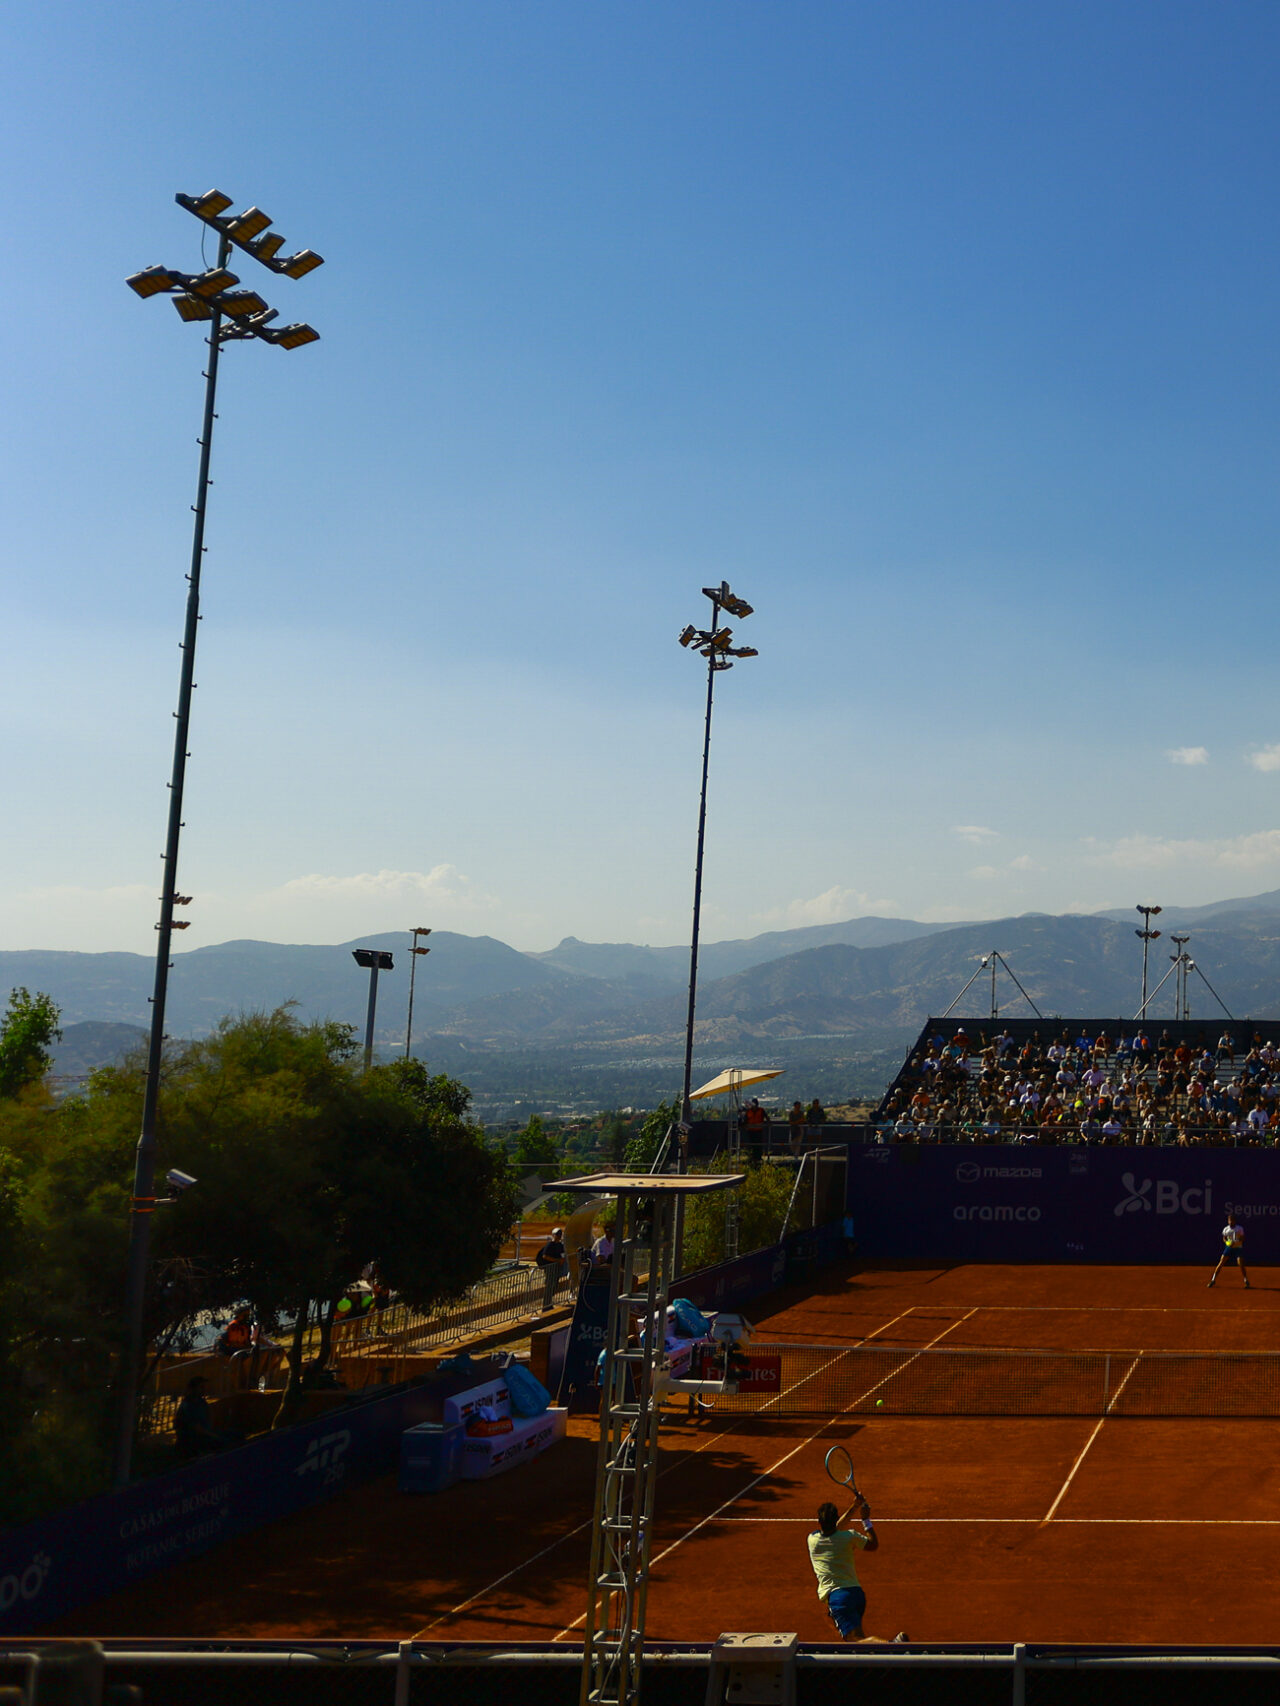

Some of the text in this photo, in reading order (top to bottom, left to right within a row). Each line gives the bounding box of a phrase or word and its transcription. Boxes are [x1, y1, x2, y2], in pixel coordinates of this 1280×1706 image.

[952, 1205, 1042, 1222] aramco
[1156, 1179, 1213, 1215] Bci
[293, 1428, 352, 1477] ATP
[119, 1505, 164, 1539] CASAS
[181, 1481, 231, 1514] BOSQUE
